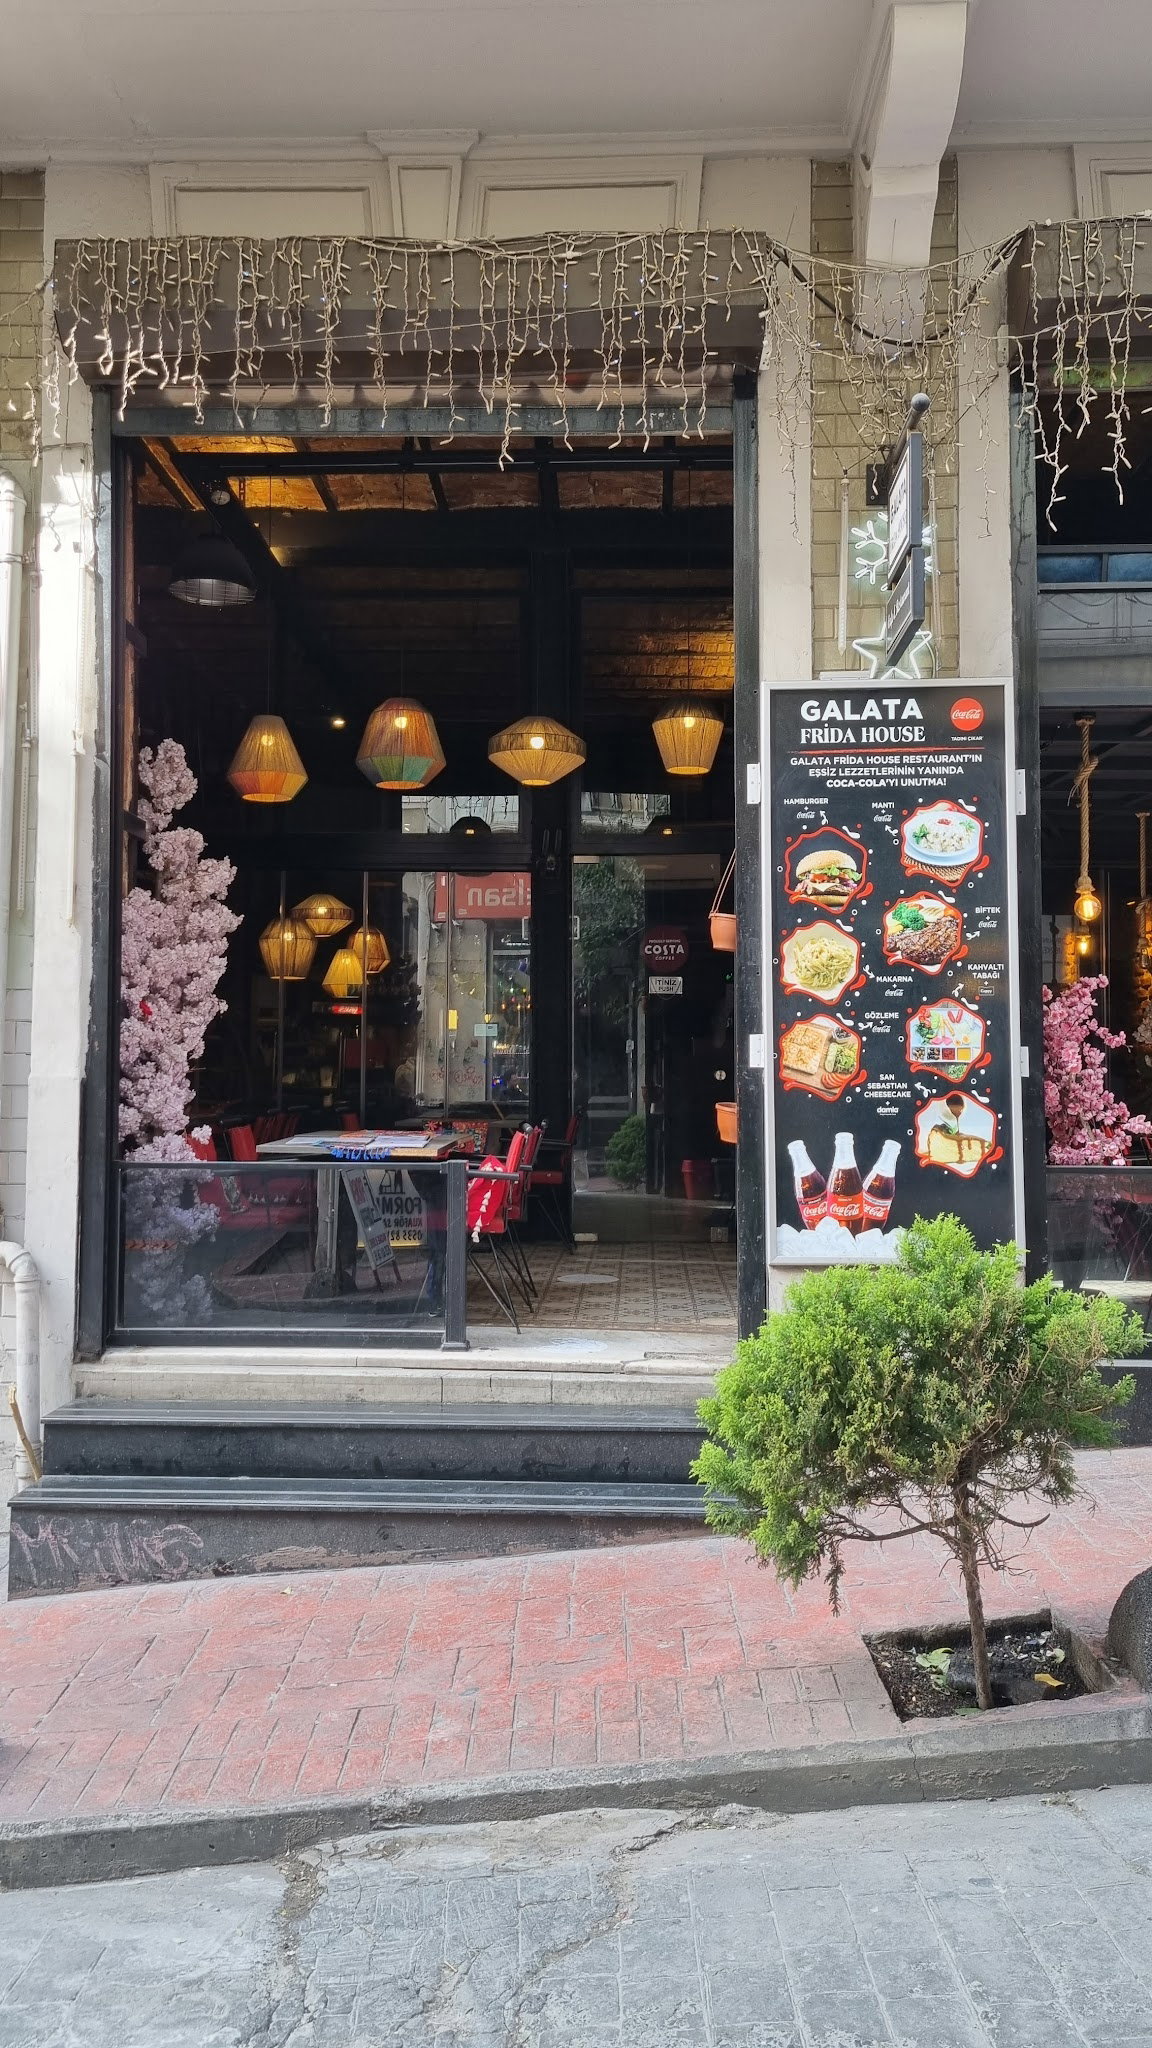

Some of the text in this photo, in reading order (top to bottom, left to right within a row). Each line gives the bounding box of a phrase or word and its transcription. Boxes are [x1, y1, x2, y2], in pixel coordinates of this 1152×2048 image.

[800, 698, 924, 722] GALATA
[800, 722, 926, 744] FRİDA HOUSE
[790, 756, 832, 766] GALATA
[833, 754, 864, 765] FRİDA
[866, 755, 900, 764] HOUSE
[808, 764, 964, 778] EŞSİZ LEZZETLERİNİN YANINDA
[900, 777, 947, 787] UNUTMA!
[783, 797, 829, 805] HAMBURGER
[871, 801, 895, 809] MANTI
[975, 905, 1001, 914] BİFTEK
[644, 944, 685, 956] COSTA
[967, 963, 1005, 971] KAHVALTI
[876, 975, 914, 983] MAKARNA
[972, 971, 1000, 979] TABAĞI
[864, 1010, 900, 1019] GÖZLEME
[879, 1073, 895, 1081] SAN
[867, 1082, 908, 1090] SEBASTIAN
[863, 1090, 912, 1098] CHEESECAKE
